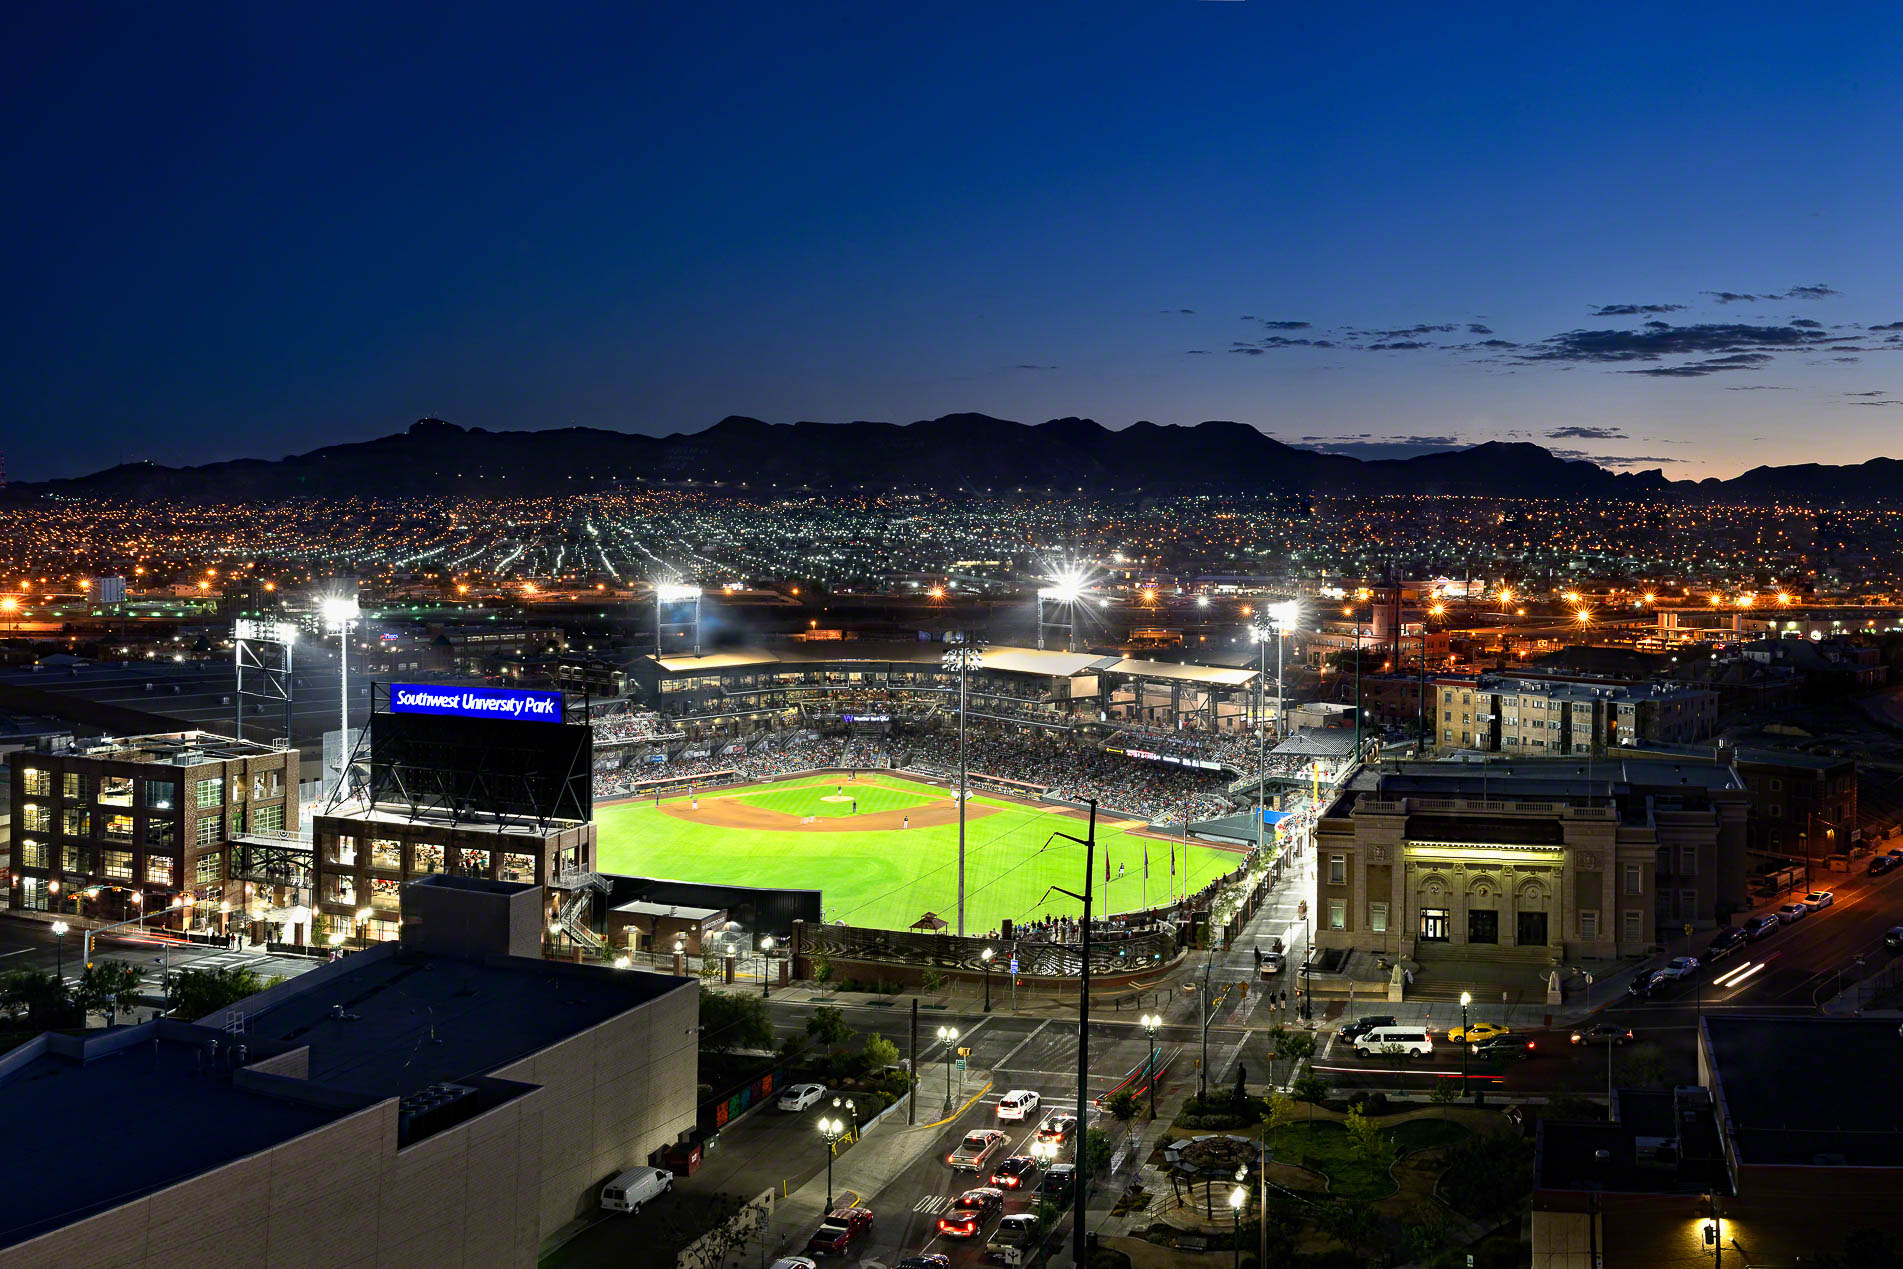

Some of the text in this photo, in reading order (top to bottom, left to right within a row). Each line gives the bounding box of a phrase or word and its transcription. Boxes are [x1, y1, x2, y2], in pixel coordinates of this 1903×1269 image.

[397, 690, 554, 716] Southwest University Park
[912, 1194, 959, 1215] ONLY
